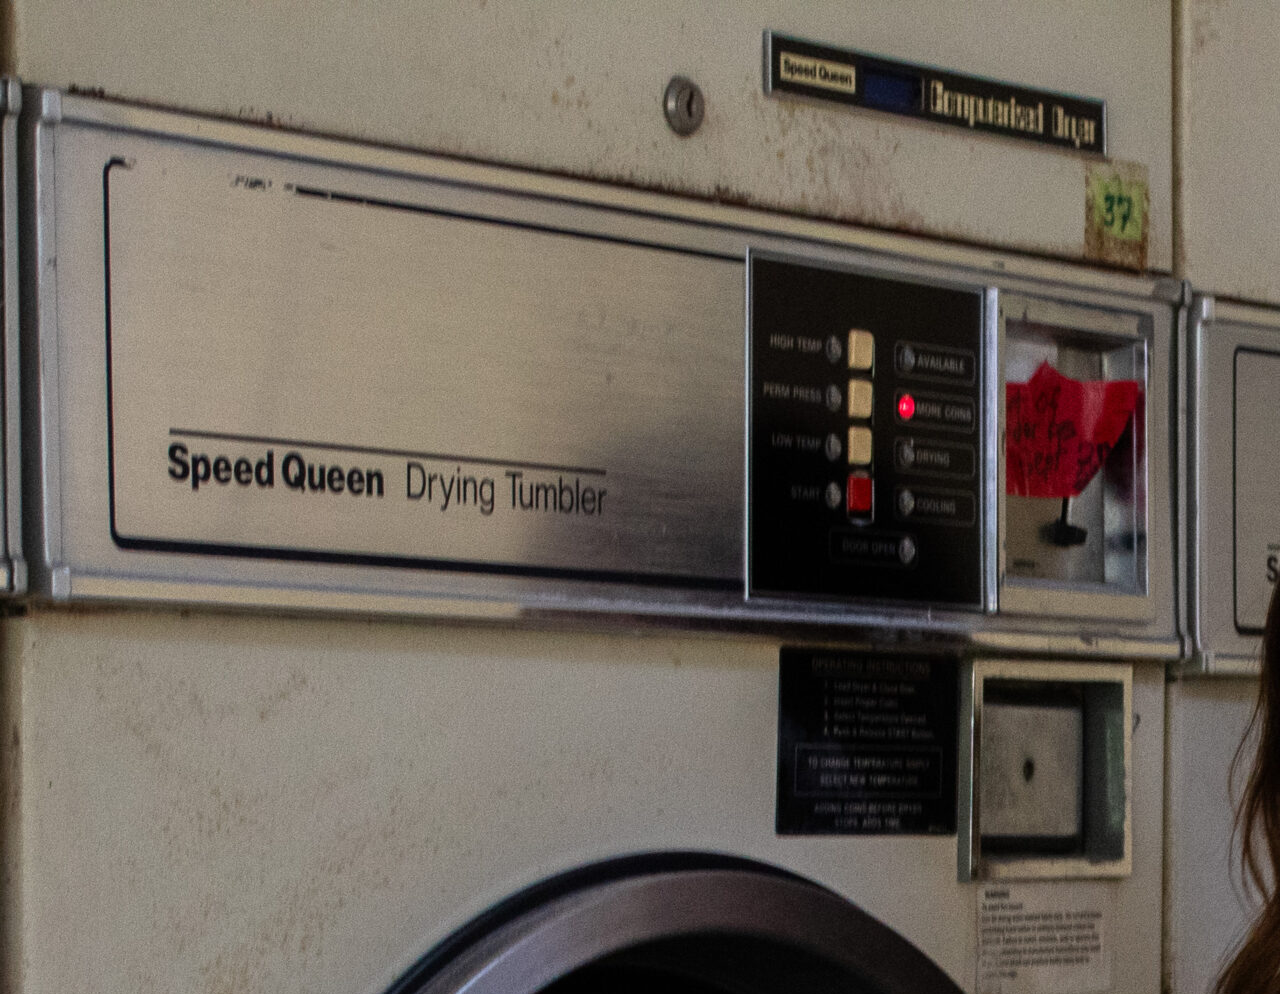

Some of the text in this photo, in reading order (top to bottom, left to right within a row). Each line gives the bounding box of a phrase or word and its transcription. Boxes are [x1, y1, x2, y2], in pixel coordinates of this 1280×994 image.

[784, 57, 852, 88] Speed Queen
[1052, 104, 1096, 149] Dryer
[1104, 194, 1132, 234] 37
[770, 334, 822, 353] HIGH TEMP
[917, 353, 965, 374] AVAILABLE
[917, 401, 941, 418] MORE
[772, 432, 821, 451] LOW TEMP
[916, 449, 950, 468] DRYING
[168, 442, 607, 515] Speed Queen Drying Tumbler
